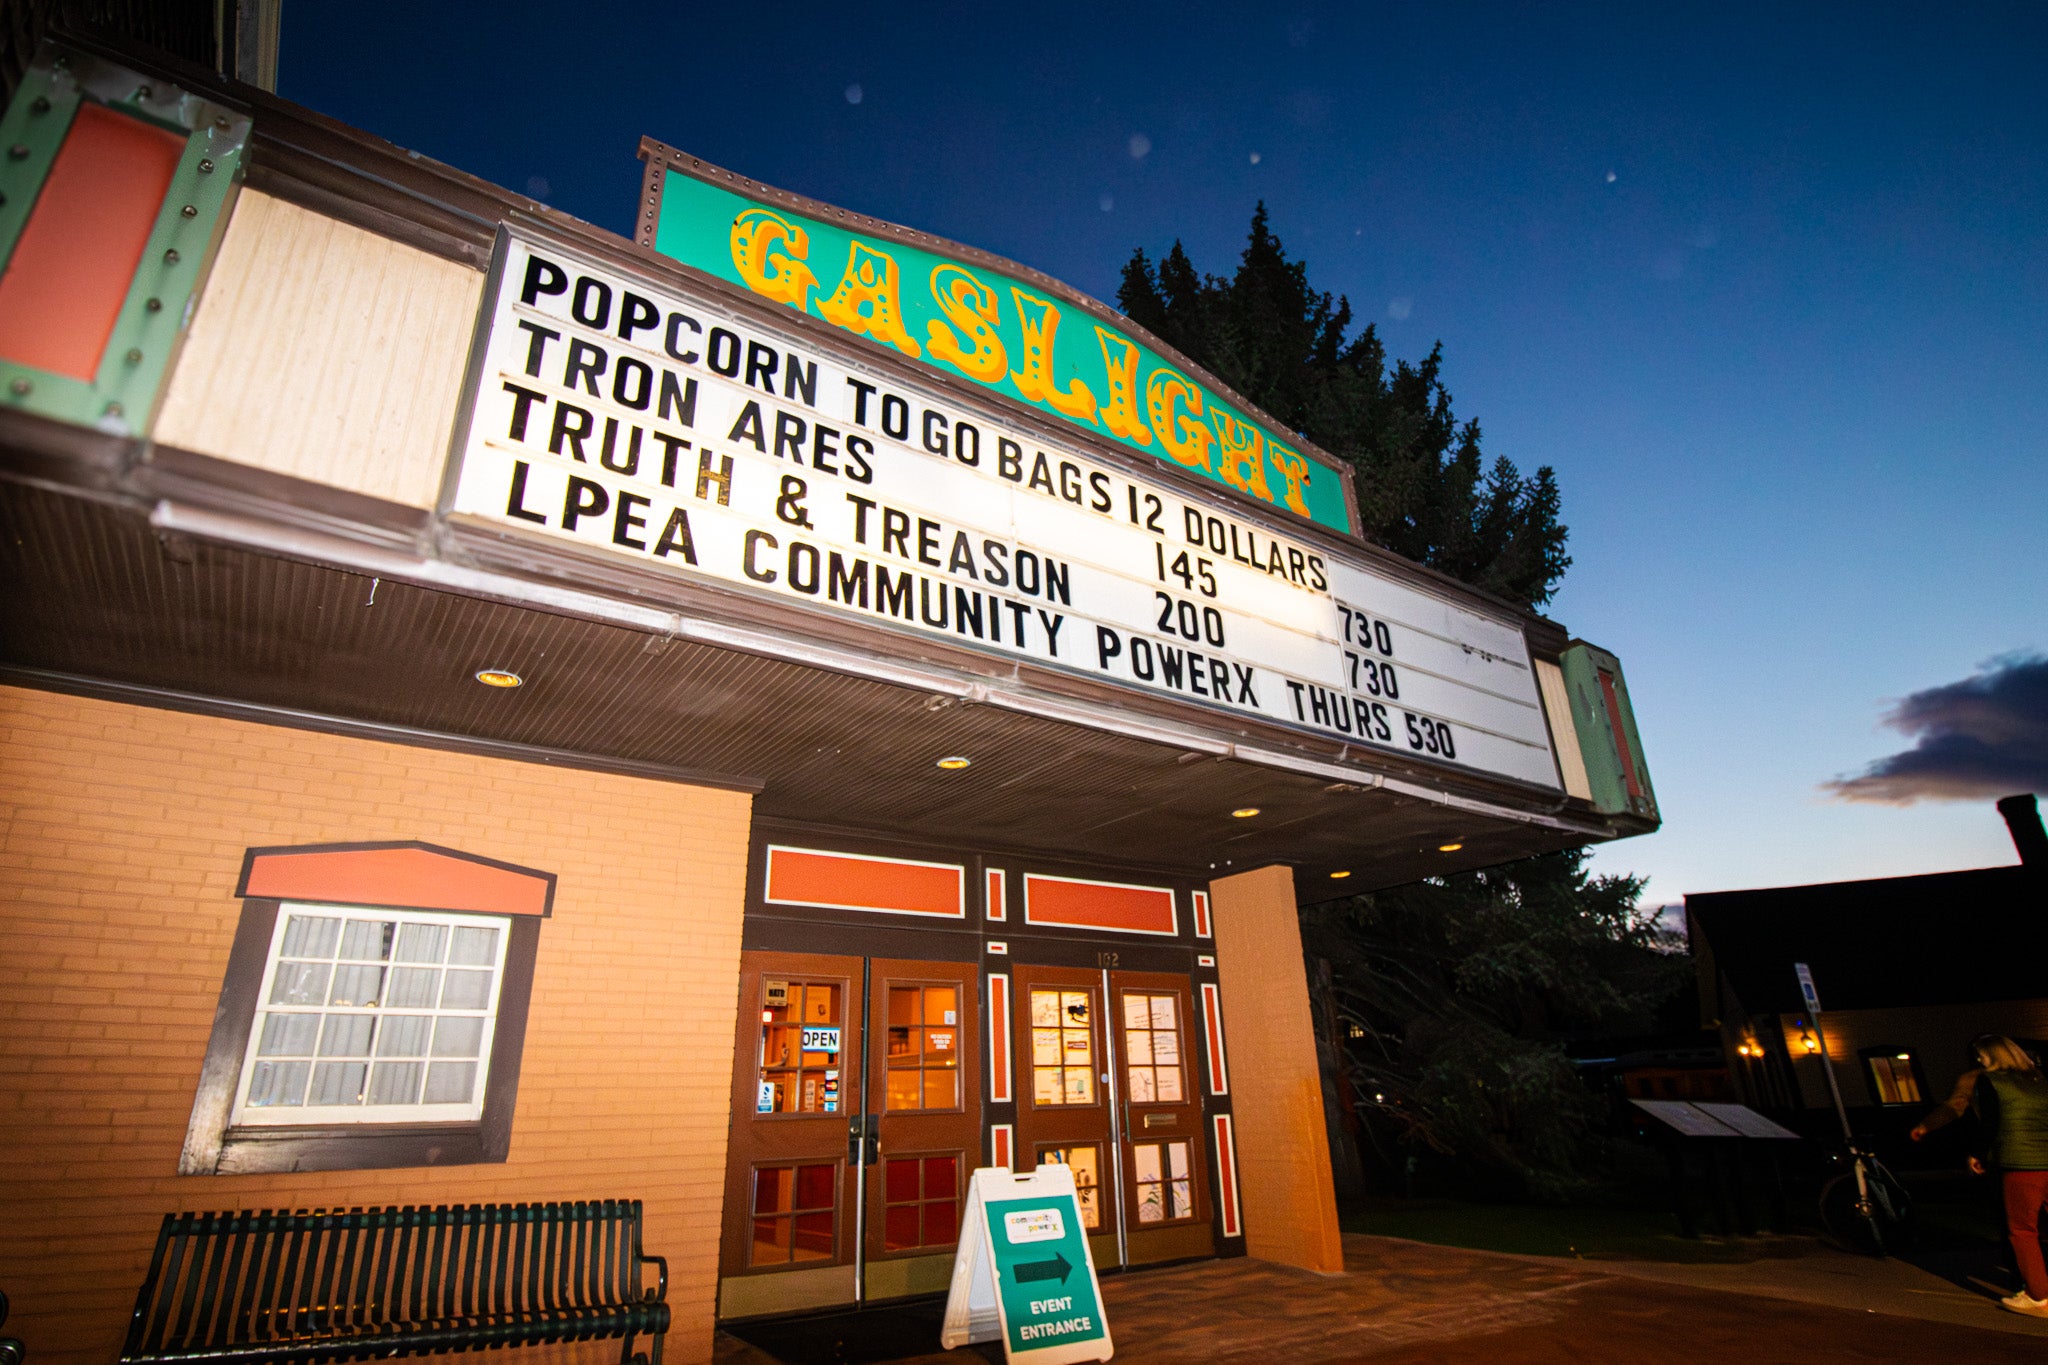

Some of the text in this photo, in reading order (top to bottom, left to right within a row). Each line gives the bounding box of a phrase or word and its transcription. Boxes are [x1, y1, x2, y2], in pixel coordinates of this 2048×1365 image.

[518, 319, 1392, 657] TRON ARES 145 730
[520, 254, 818, 407] POPCORN
[998, 435, 1113, 513] BAGS
[1128, 485, 1166, 535] 12
[1184, 506, 1328, 592] DOLLARS
[730, 208, 1311, 520] GASLIGHT
[502, 382, 1399, 701] TRUTH & TREASON 200 730
[506, 460, 1456, 760] LPEA COMMUNITY POWERX THURS 530
[803, 1031, 838, 1047] OPEN
[1020, 1318, 1091, 1340] ENTRANCE
[1030, 1297, 1072, 1315] EVENT
